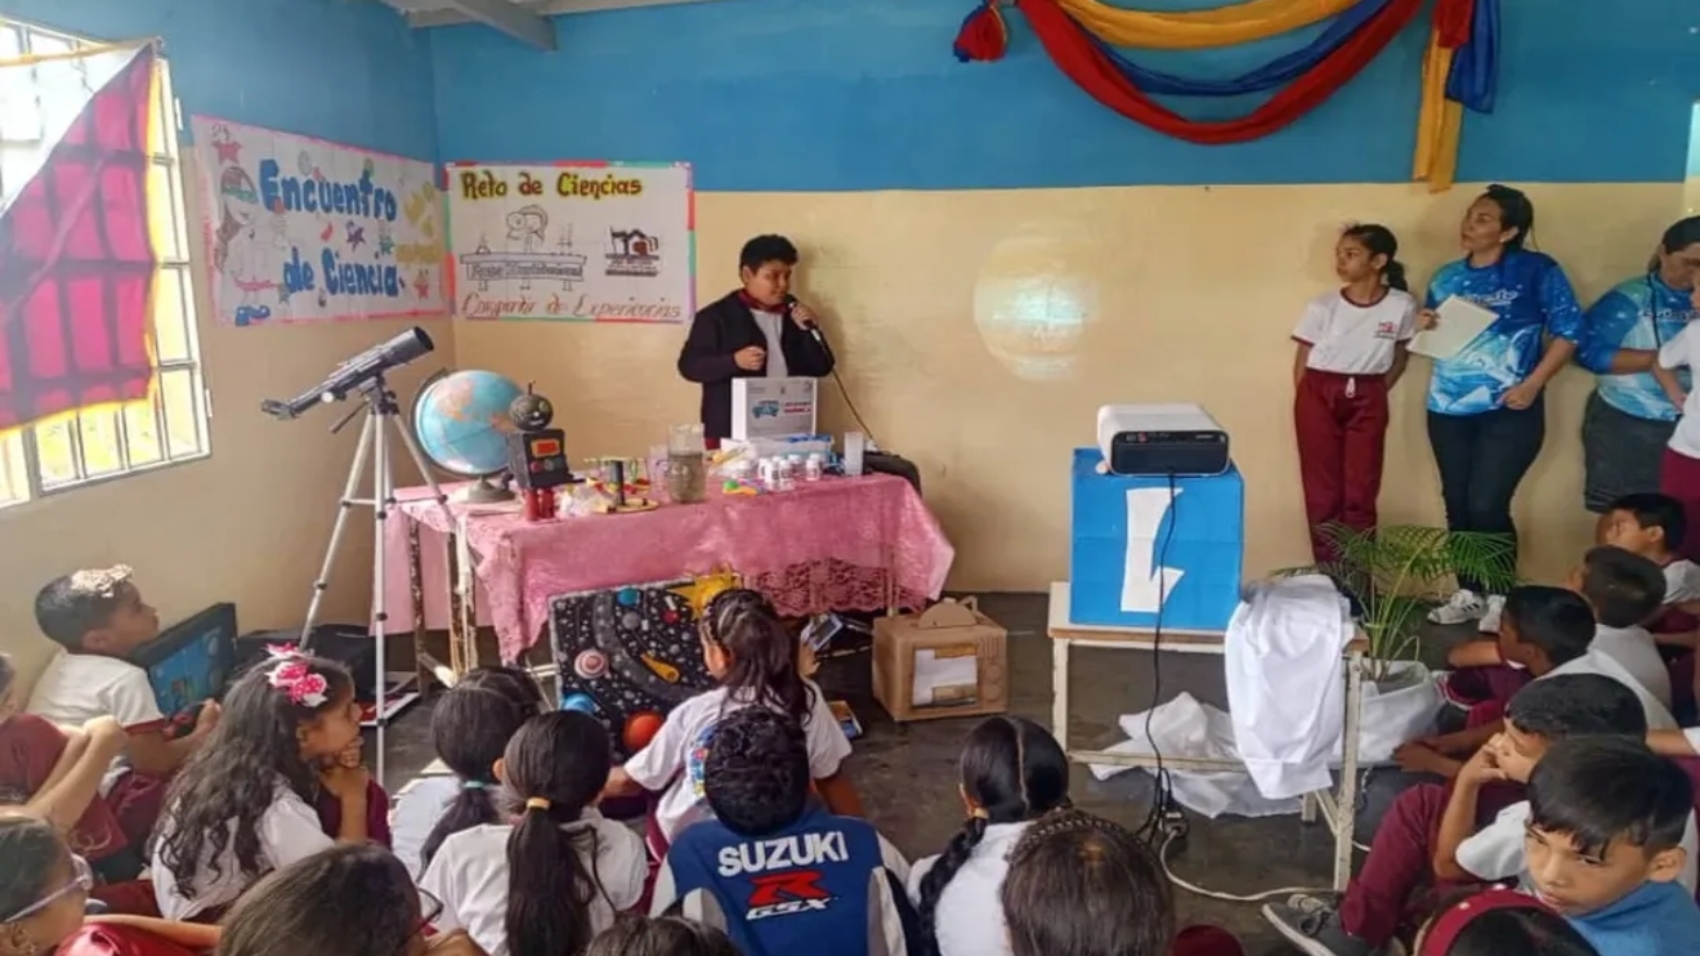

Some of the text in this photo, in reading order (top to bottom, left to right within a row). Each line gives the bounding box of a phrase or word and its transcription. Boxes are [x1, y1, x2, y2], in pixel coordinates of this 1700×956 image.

[258, 157, 398, 221] Encuentro
[461, 170, 643, 199] Reto de Ciencias
[283, 246, 315, 293] de
[718, 831, 849, 877] SUZUKI
